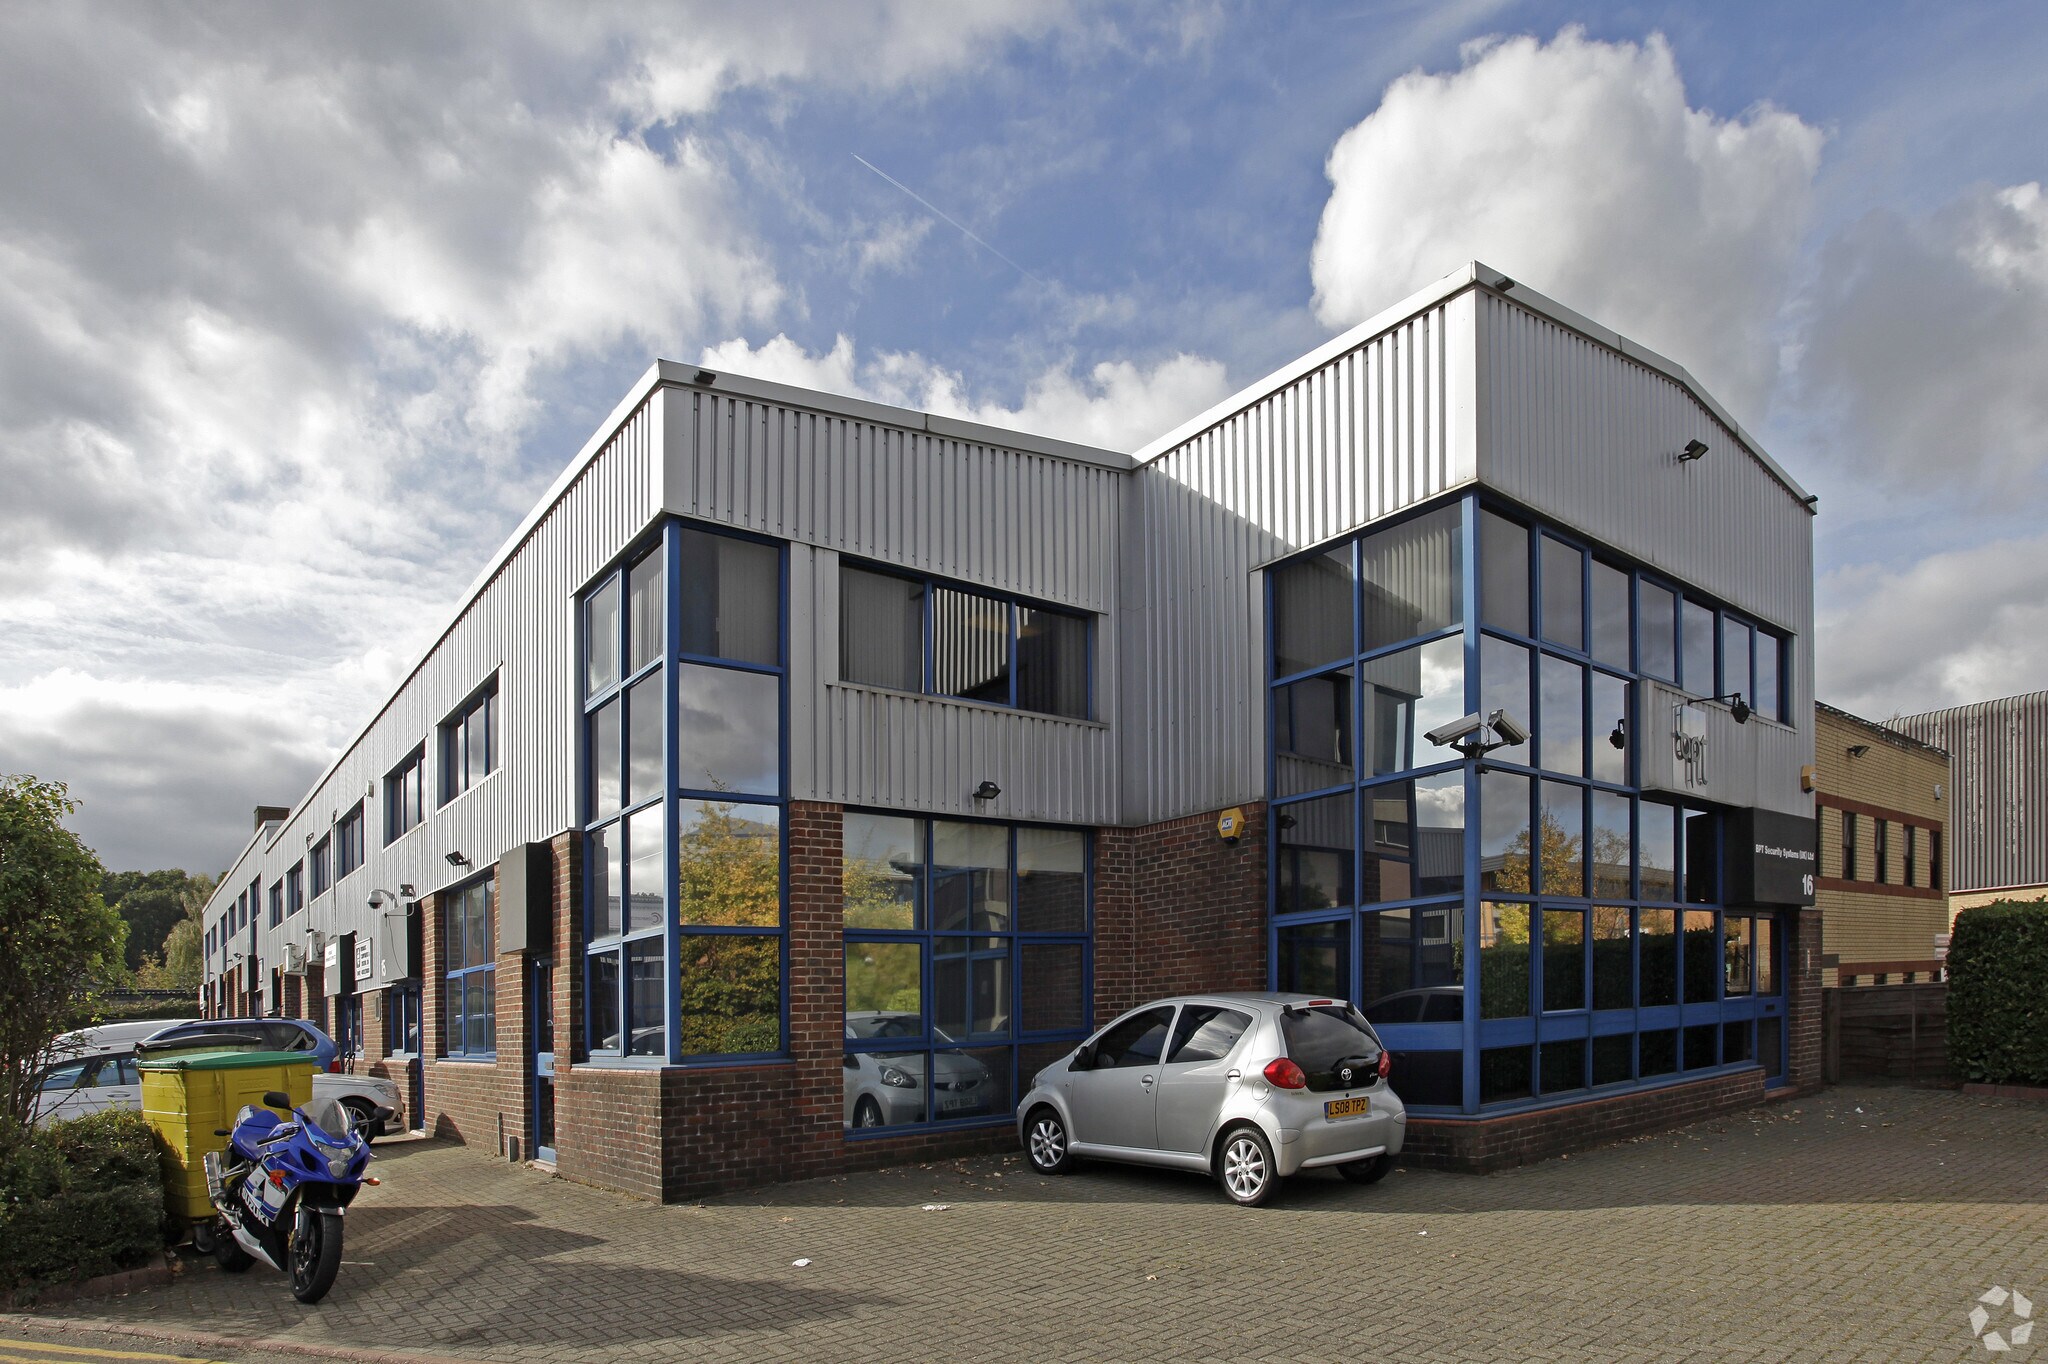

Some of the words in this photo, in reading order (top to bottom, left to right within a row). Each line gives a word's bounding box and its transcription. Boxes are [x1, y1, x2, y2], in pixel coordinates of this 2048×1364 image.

[1755, 844, 1764, 853] BPT
[1764, 846, 1782, 858] Security
[1783, 848, 1799, 859] Systems
[1807, 851, 1815, 861] Ltd
[1802, 873, 1814, 896] 16
[1329, 1102, 1350, 1116] LS08
[1352, 1098, 1366, 1113] TPZ
[241, 1187, 270, 1228] SUZUKI
